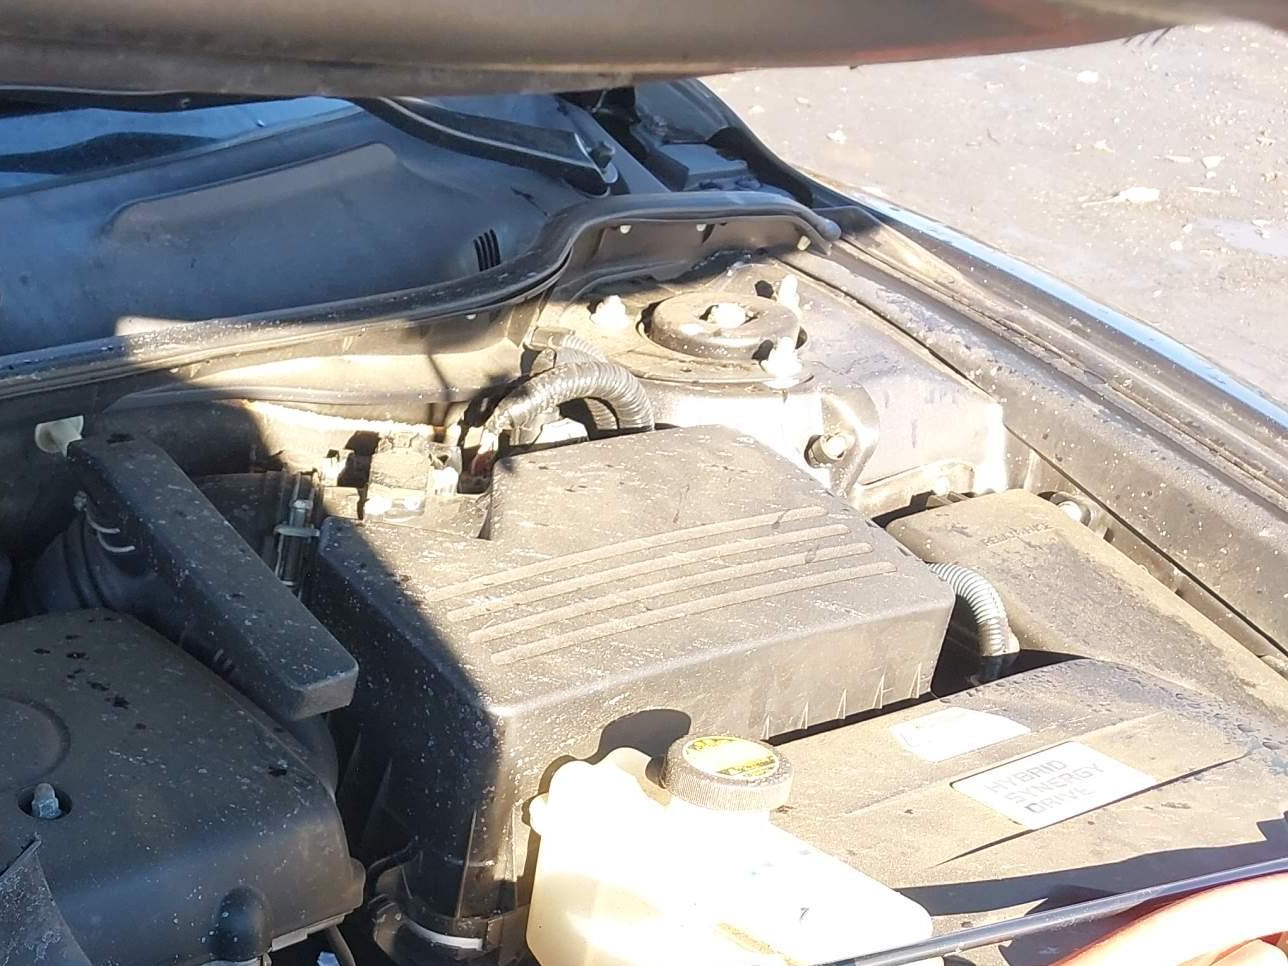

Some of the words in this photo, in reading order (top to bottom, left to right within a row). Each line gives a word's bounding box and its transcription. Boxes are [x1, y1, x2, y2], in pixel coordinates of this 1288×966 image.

[984, 759, 1067, 793] HYBRID
[1004, 763, 1105, 805] SYNERGY
[1023, 787, 1096, 814] DRIVE
